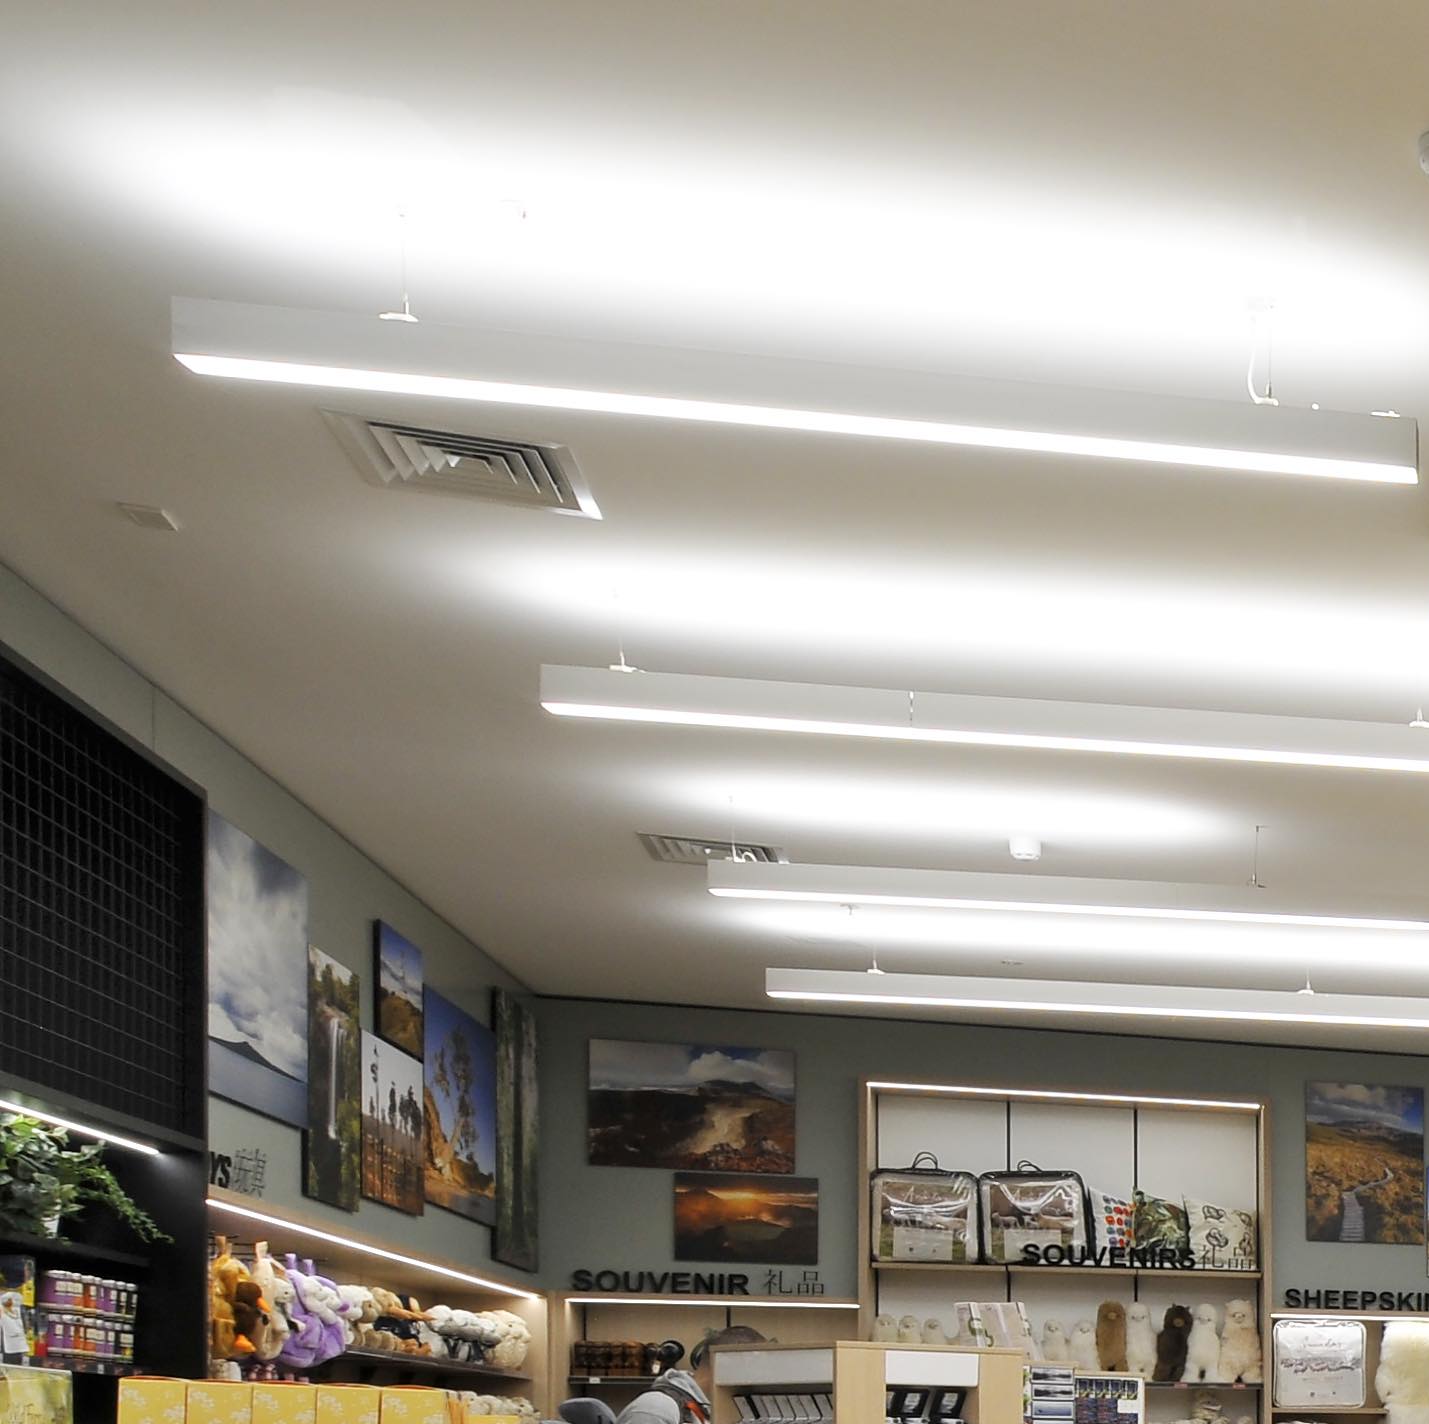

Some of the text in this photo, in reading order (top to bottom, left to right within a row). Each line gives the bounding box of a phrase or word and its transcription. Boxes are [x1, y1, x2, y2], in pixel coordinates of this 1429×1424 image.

[1023, 1243, 1196, 1269] SOUVENIRS
[1201, 1244, 1253, 1269] 礼品
[572, 1269, 749, 1295] SOUVENIR
[763, 1269, 825, 1295] 礼品
